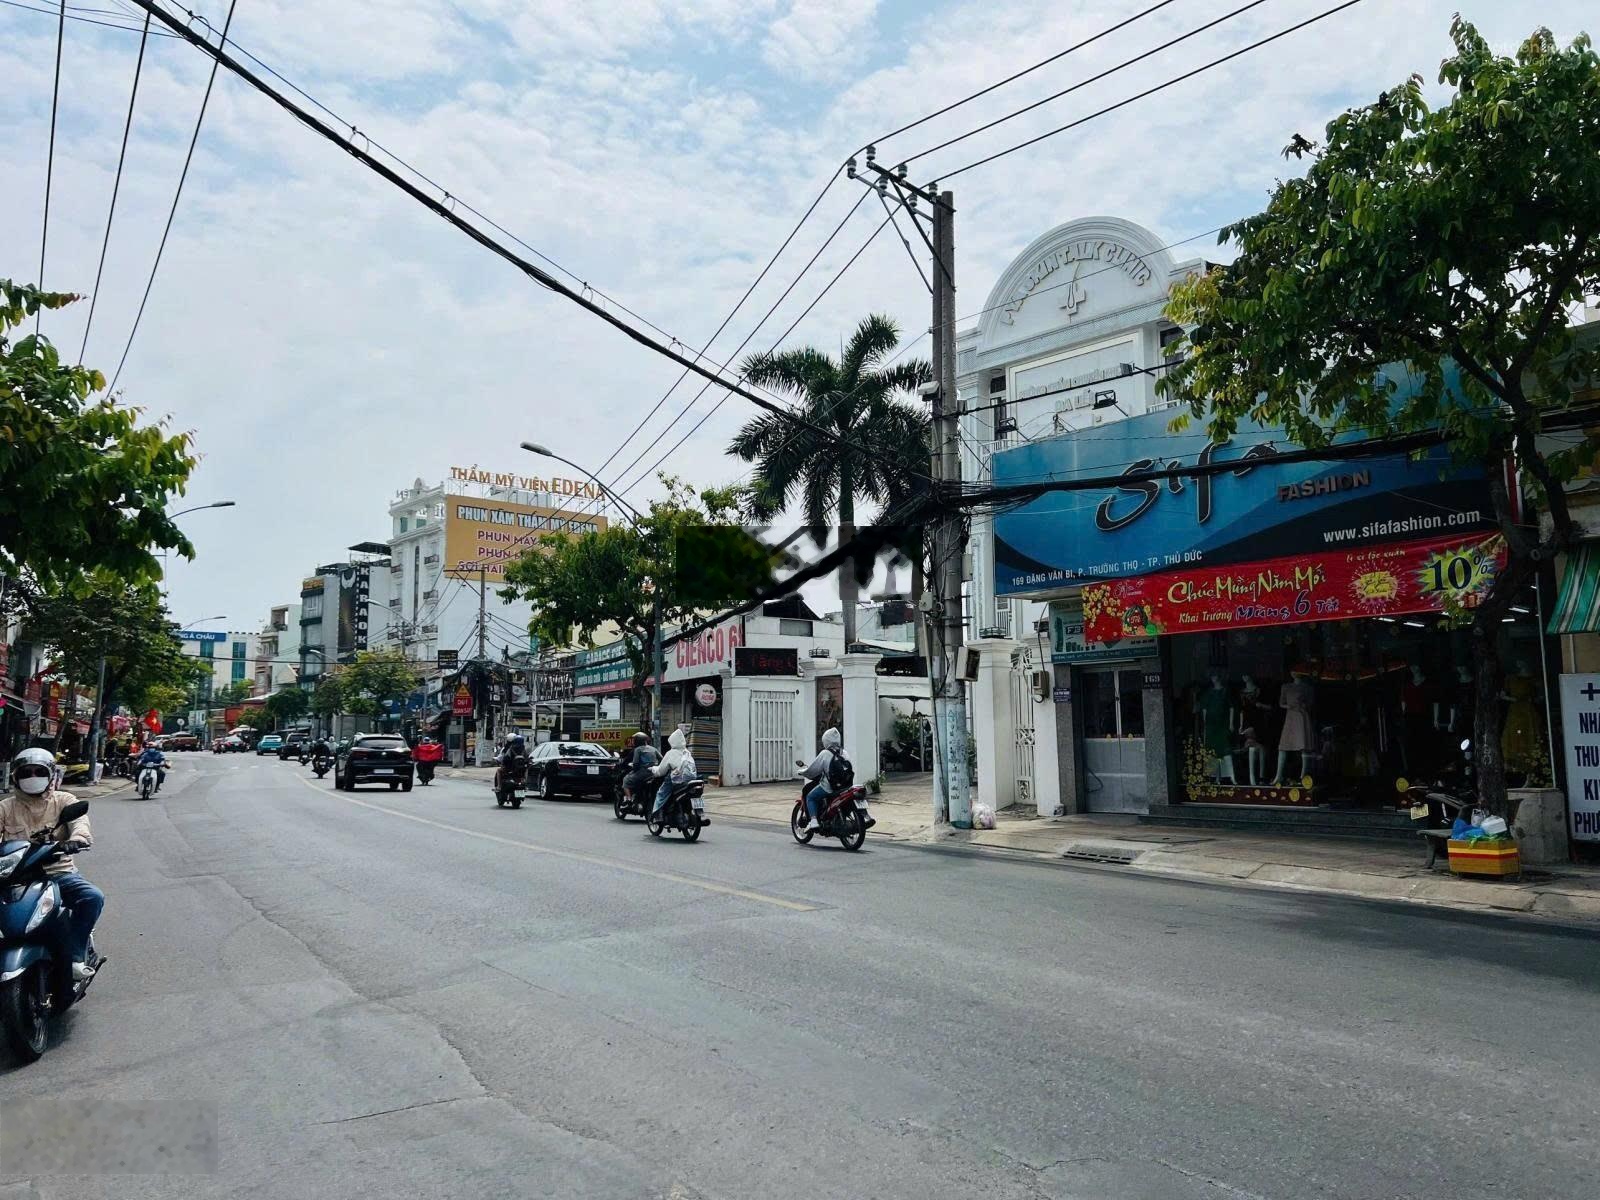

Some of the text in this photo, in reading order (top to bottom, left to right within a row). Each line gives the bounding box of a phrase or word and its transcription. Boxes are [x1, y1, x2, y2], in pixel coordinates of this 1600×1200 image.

[1277, 469, 1370, 501] FASHION
[456, 504, 489, 523] PHUN
[1323, 509, 1481, 543] www.sifafashion.com
[477, 530, 511, 543] PHUN
[478, 547, 511, 558] PHUN
[1012, 576, 1025, 587] 169
[1147, 556, 1162, 567] TP.
[1257, 569, 1294, 598] Năm
[1429, 552, 1489, 592] 10%
[357, 567, 370, 645] KARAOK
[1178, 610, 1200, 624] Khai
[1293, 588, 1311, 616] 6
[676, 627, 725, 669] CIENCO
[1579, 712, 1600, 734] NH
[1583, 778, 1600, 801] KI
